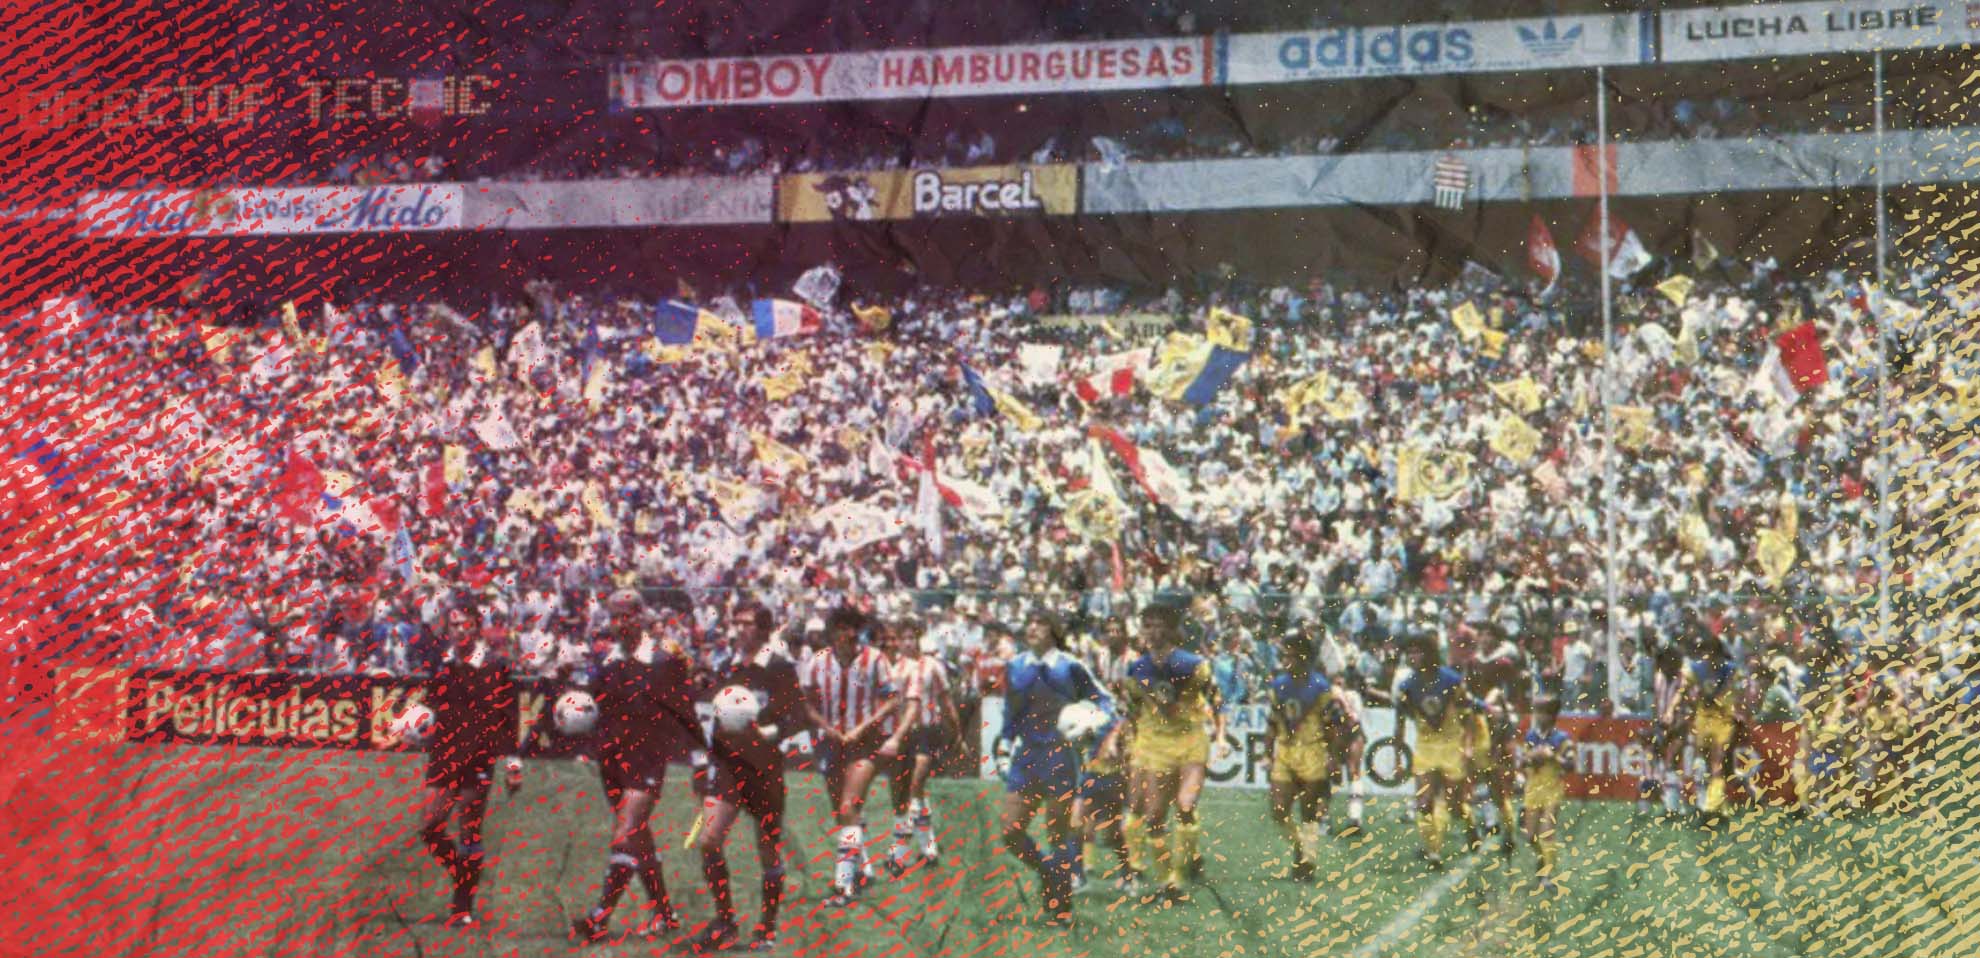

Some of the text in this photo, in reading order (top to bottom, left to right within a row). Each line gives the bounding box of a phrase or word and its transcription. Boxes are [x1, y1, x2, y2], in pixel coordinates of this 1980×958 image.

[1686, 15, 1808, 41] LUCHA
[1826, 6, 1938, 32] LIBRE
[883, 46, 1194, 88] HAMBURGUESAS
[1278, 26, 1474, 69] adidas
[300, 75, 492, 120] TECIC
[316, 186, 444, 227] Mido
[914, 169, 1040, 212] Barcel
